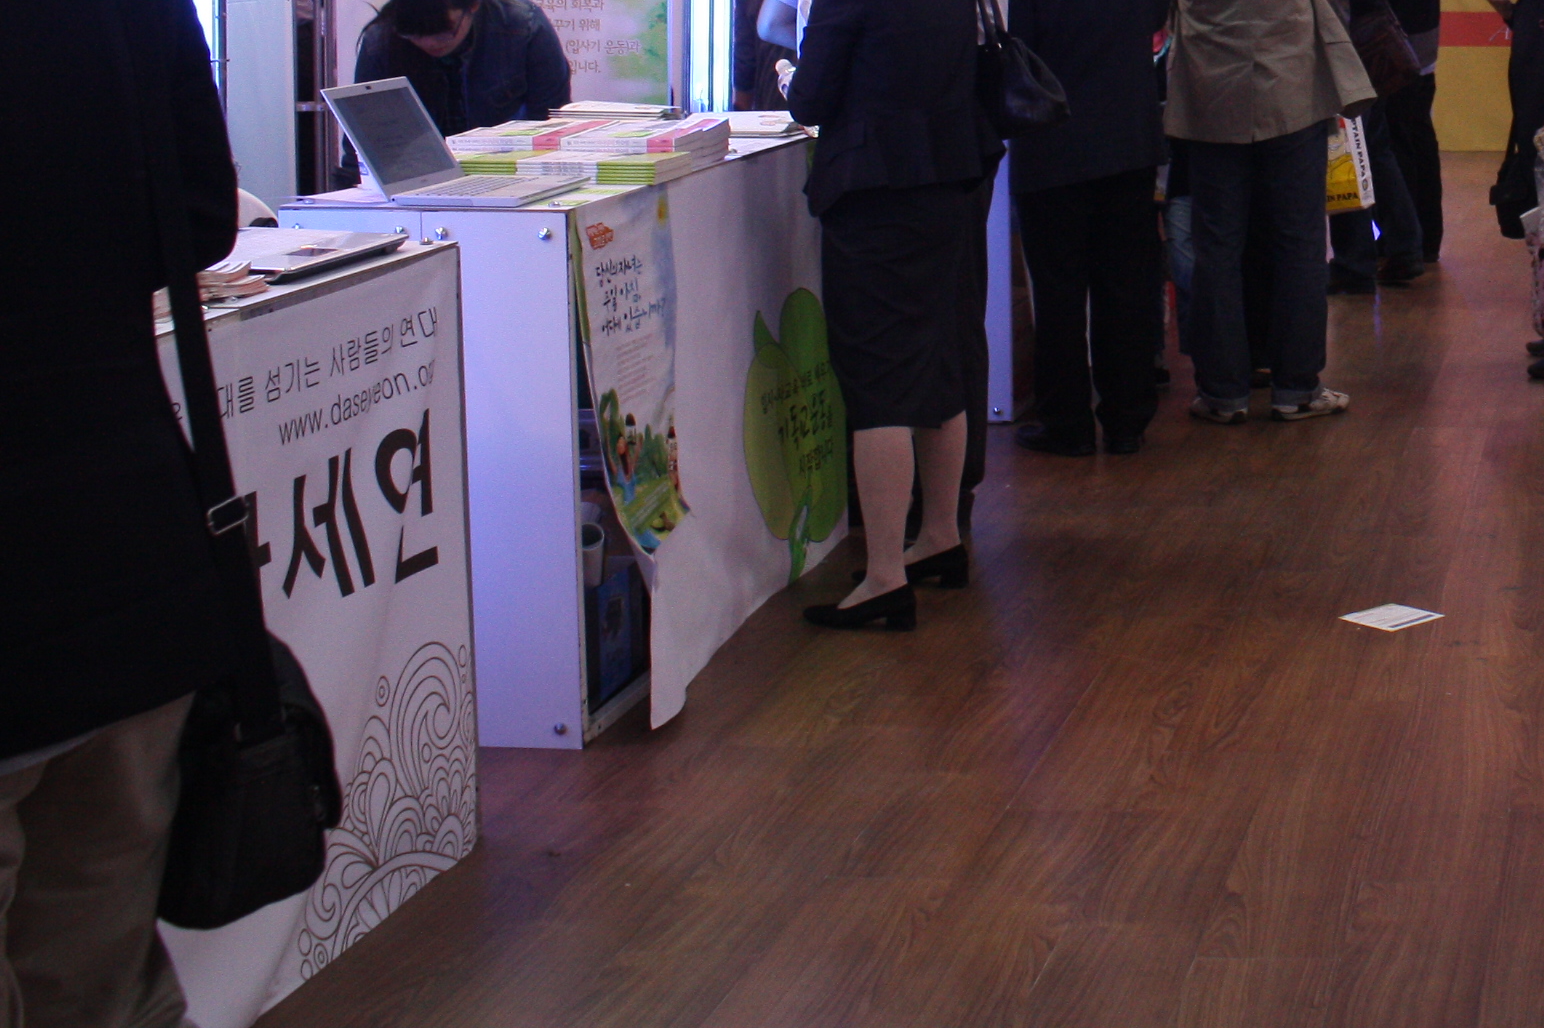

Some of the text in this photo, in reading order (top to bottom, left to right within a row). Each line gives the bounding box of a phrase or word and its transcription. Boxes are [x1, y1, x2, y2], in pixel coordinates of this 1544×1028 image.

[1336, 192, 1359, 202] PAPA
[265, 357, 321, 403] 섬기는
[330, 323, 394, 377] 사람들의
[244, 409, 439, 600] 세연
